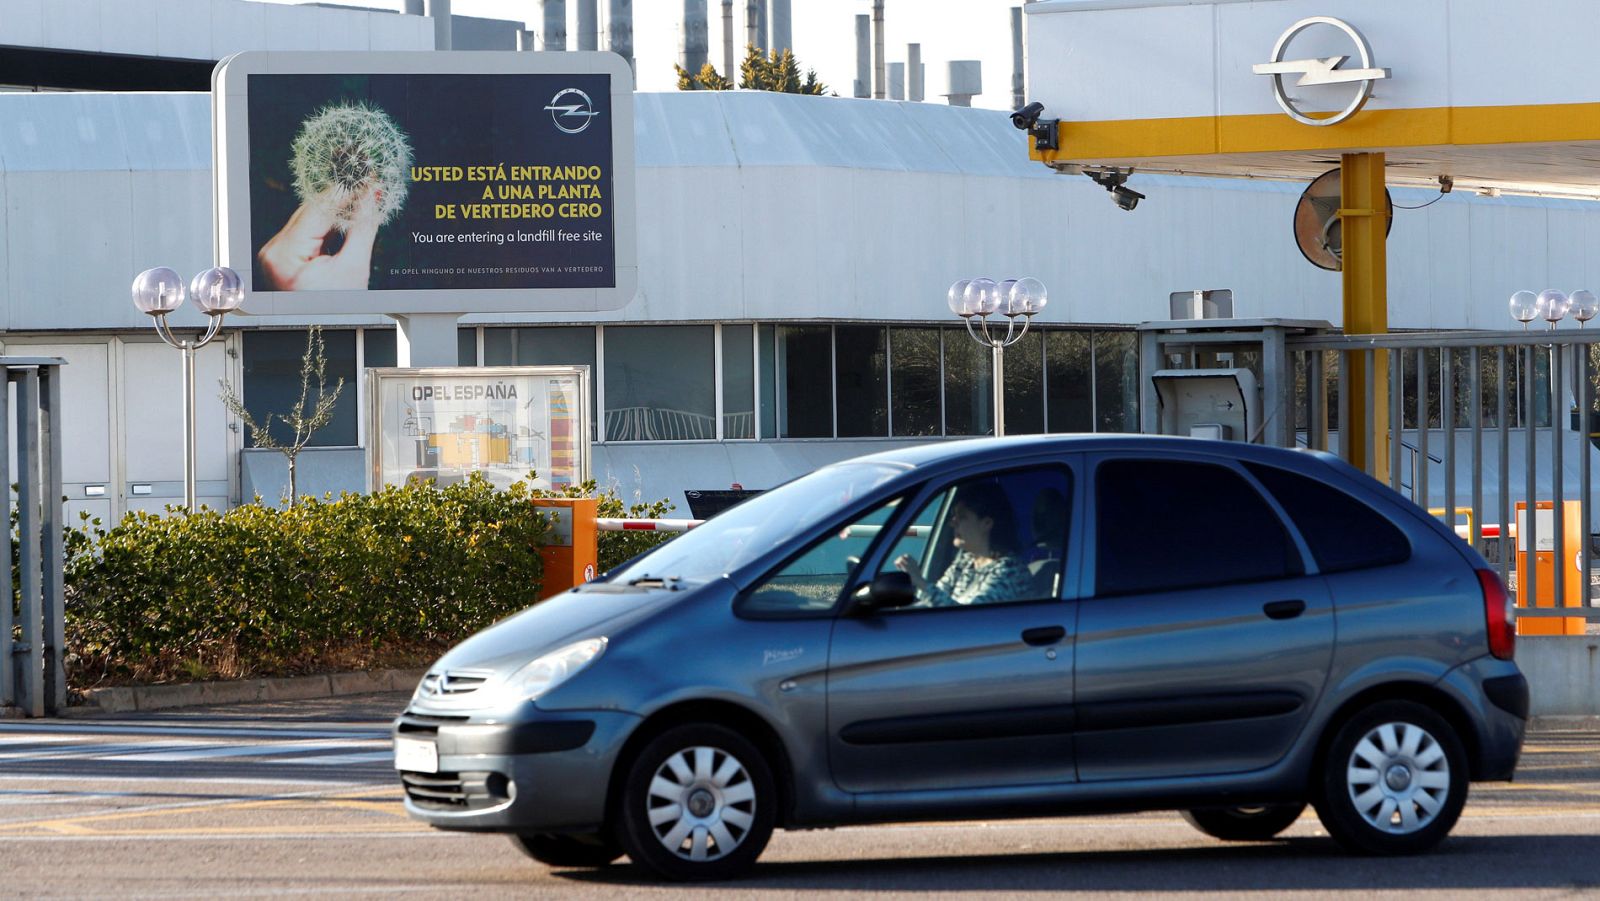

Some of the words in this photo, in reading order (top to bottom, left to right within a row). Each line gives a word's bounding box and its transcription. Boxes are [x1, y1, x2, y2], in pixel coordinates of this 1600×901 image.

[411, 166, 464, 181] USTED
[467, 162, 507, 181] ESTÁ
[511, 165, 602, 181] ENTRANDO
[482, 184, 495, 200] A
[498, 184, 534, 200] UNA
[538, 184, 602, 199] PLANTA
[435, 204, 456, 219] DE
[460, 203, 555, 219] VERTEDERO
[558, 202, 602, 218] CERO
[411, 231, 433, 243] You
[436, 233, 455, 243] are
[457, 231, 504, 245] entering
[506, 233, 515, 242] a
[517, 229, 555, 242] landfill
[558, 229, 580, 242] free
[582, 230, 602, 242] site
[564, 265, 604, 273] VERTEDERO
[412, 385, 451, 401] OPEL
[454, 380, 518, 400] ESPAÑA
